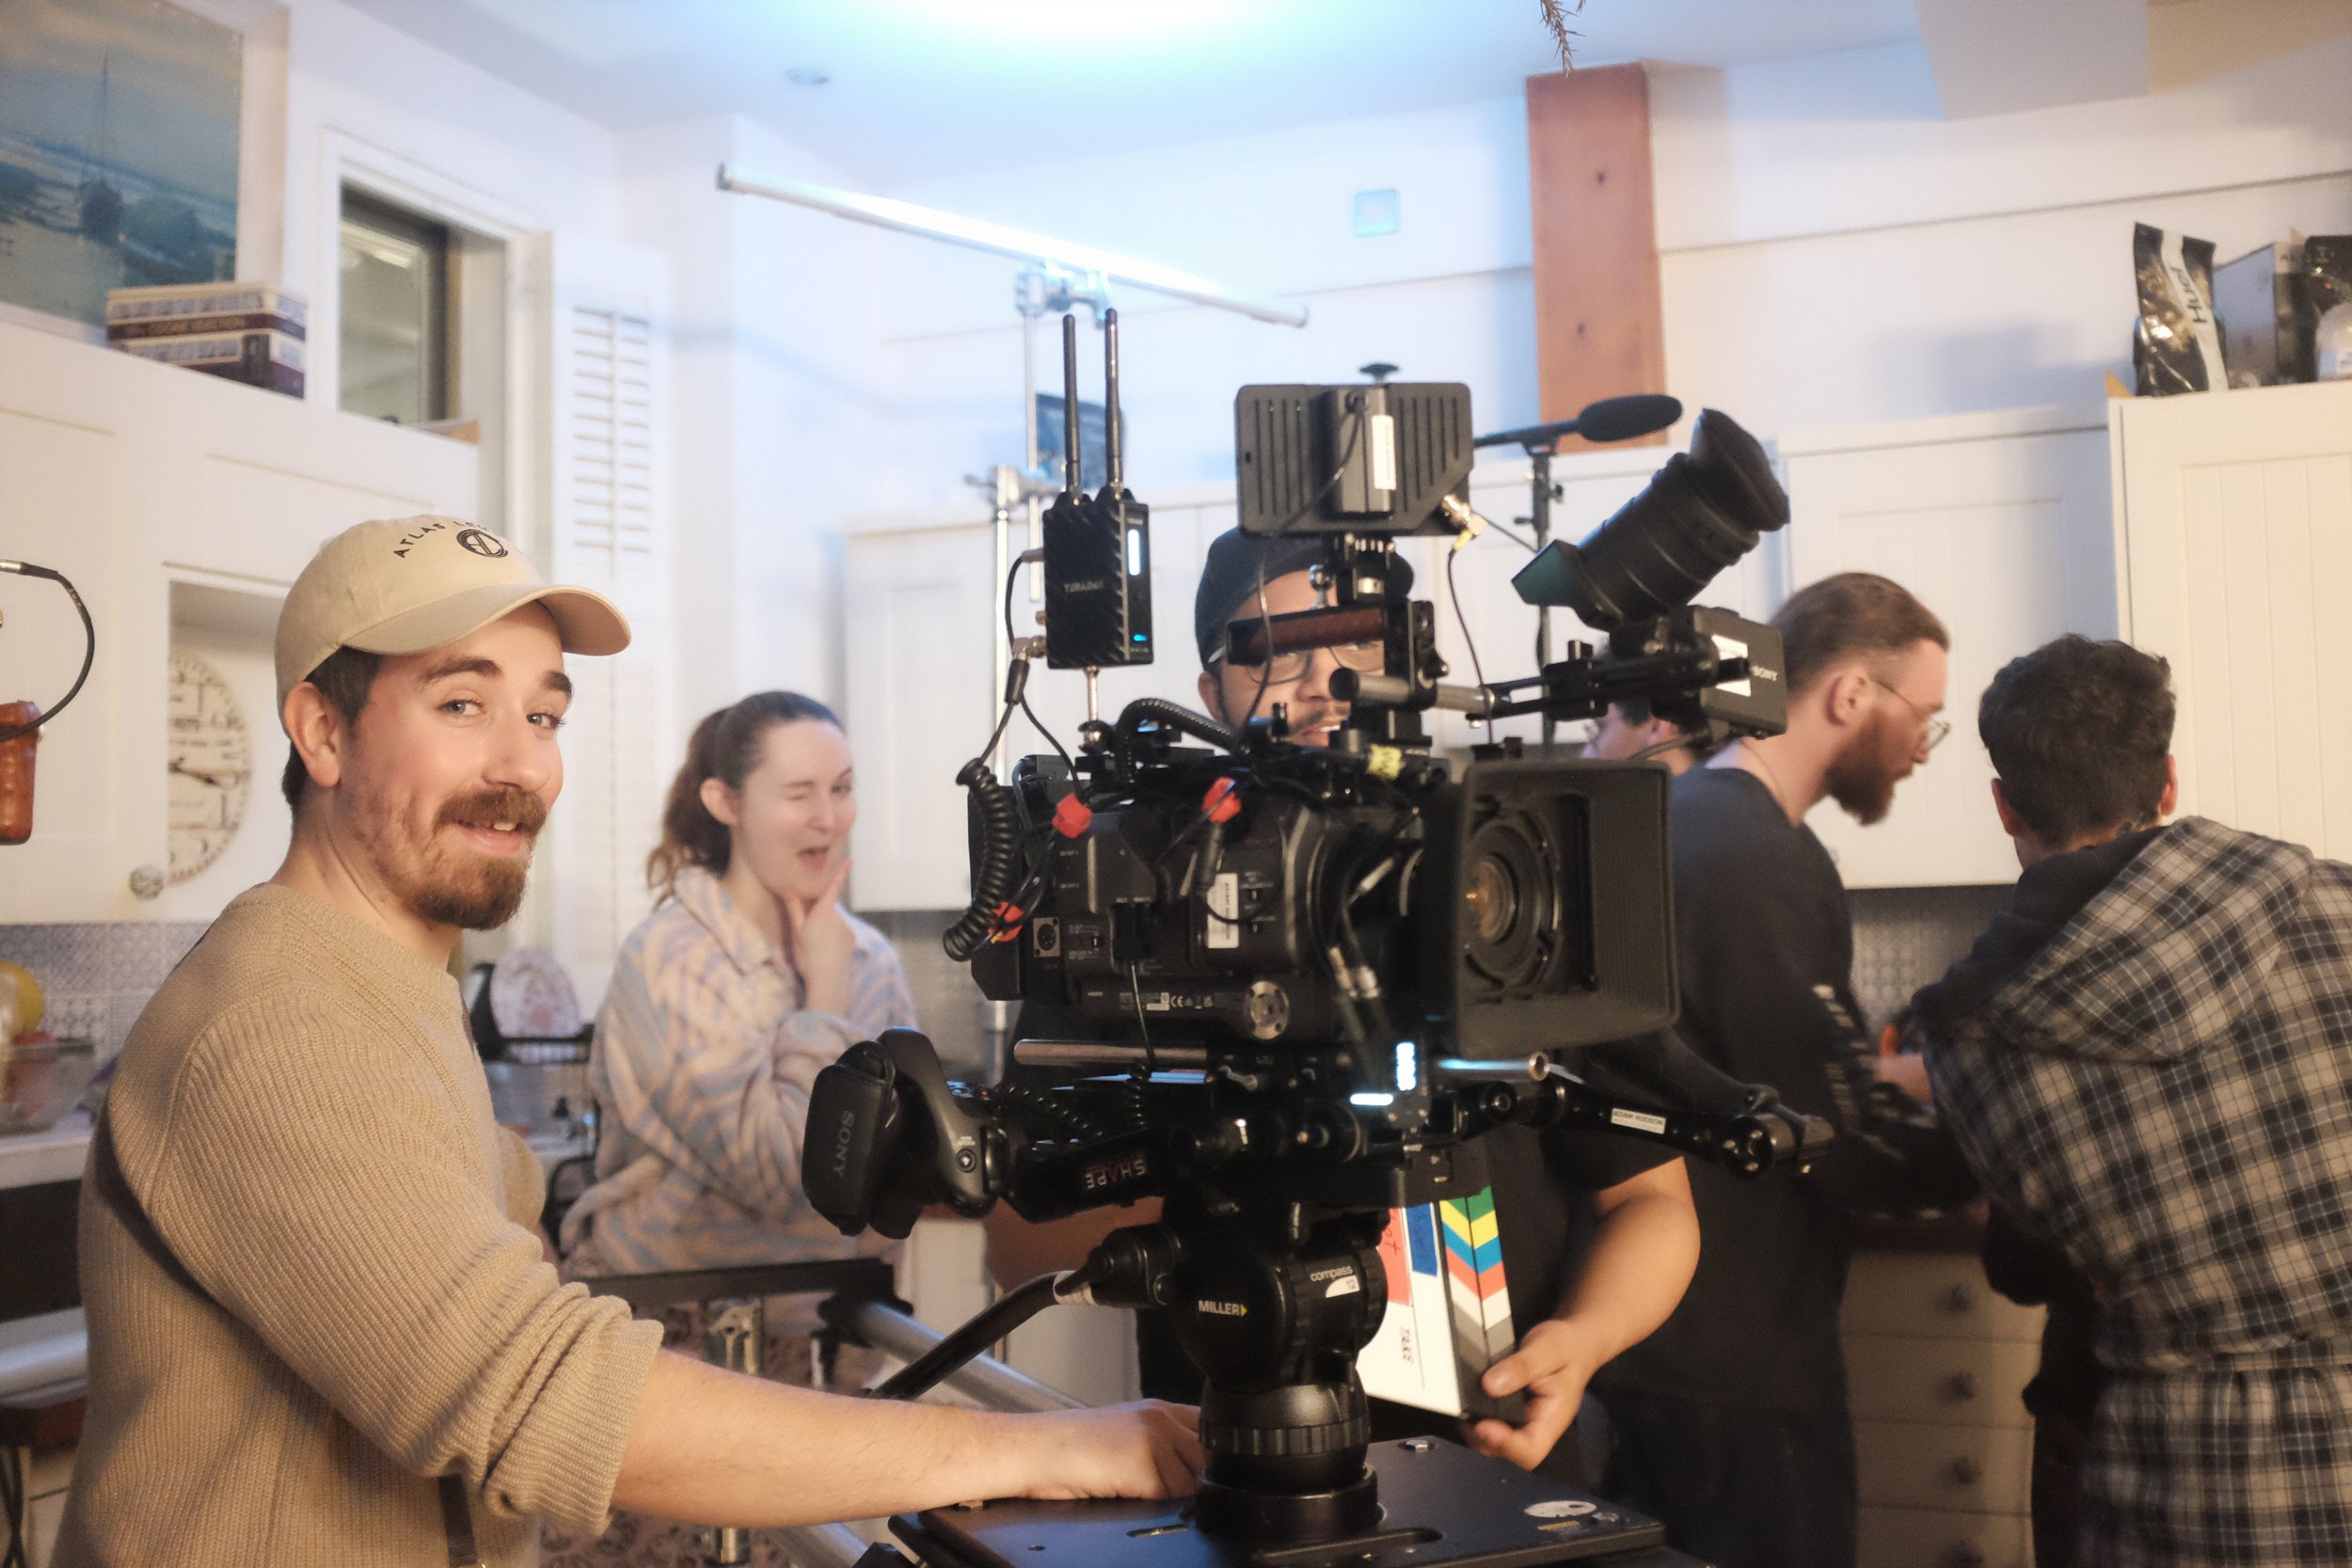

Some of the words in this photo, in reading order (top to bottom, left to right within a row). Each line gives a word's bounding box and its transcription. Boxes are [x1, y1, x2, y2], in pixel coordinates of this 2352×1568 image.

[393, 523, 446, 559] ATLAS
[833, 1110, 855, 1179] SONY
[1084, 1159, 1146, 1190] SHAPE
[1310, 1264, 1354, 1282] compass
[1345, 1278, 1357, 1290] 12
[1198, 1299, 1240, 1317] MILLER
